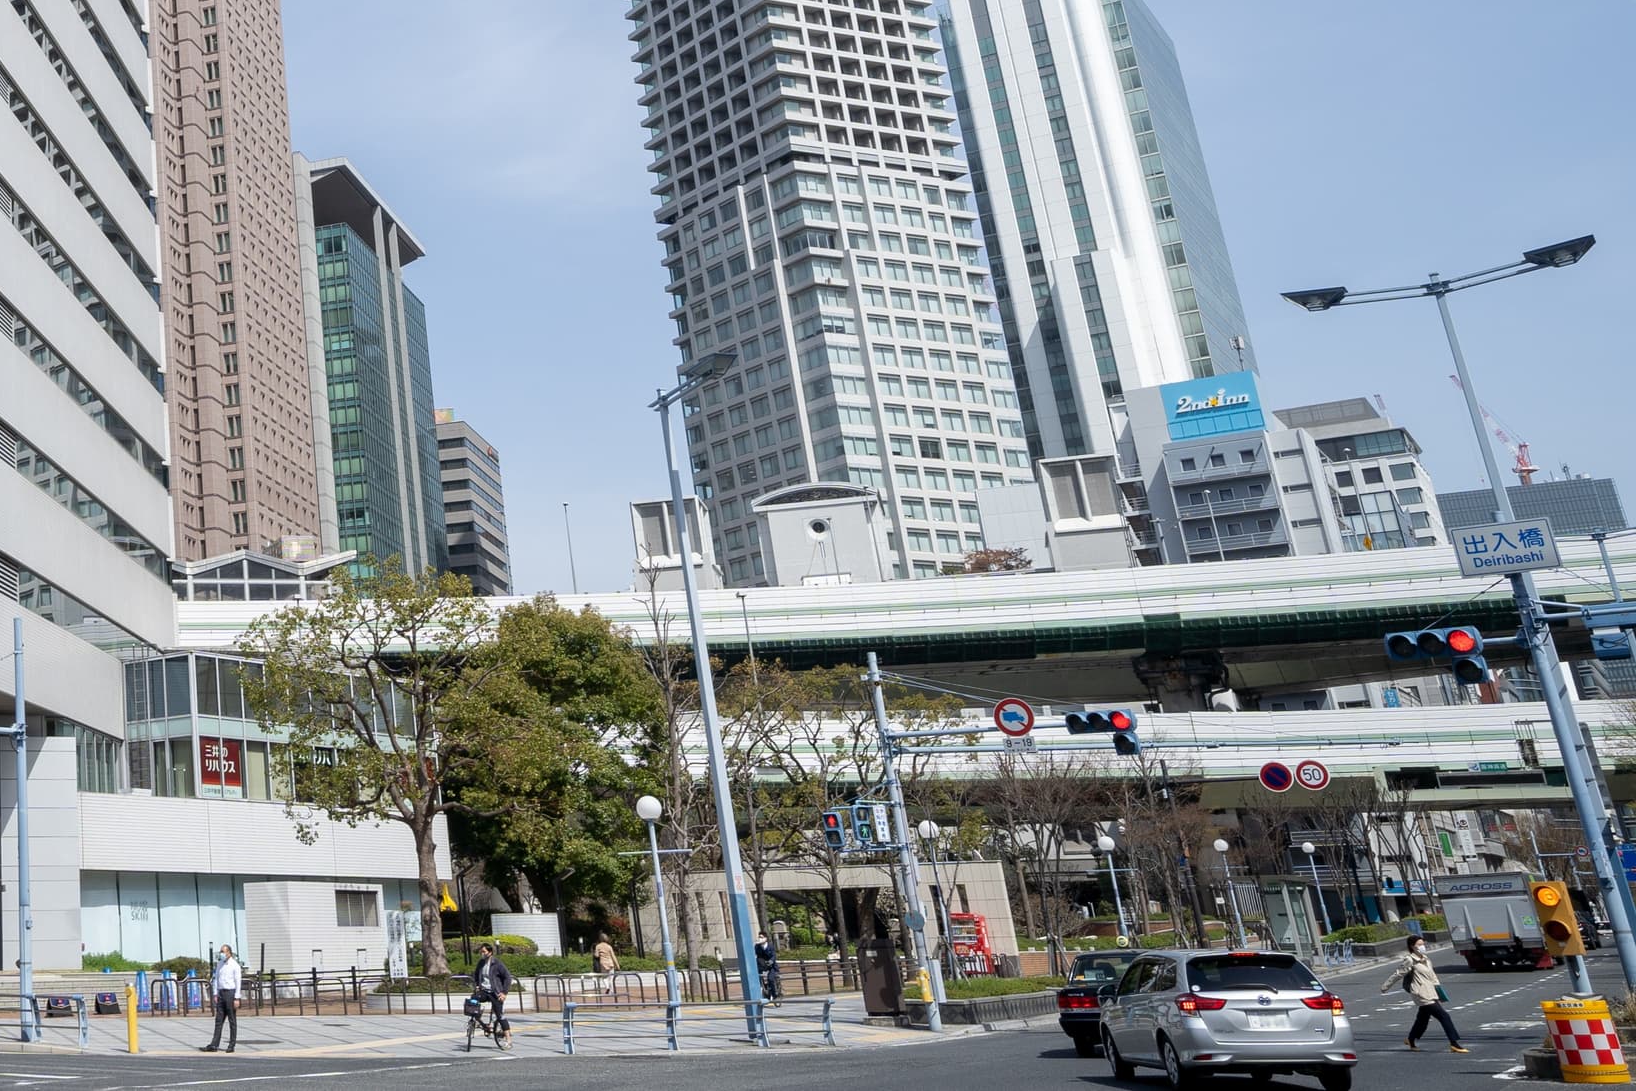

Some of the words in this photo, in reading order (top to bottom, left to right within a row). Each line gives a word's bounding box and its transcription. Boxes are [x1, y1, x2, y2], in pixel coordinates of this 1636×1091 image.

[1462, 527, 1545, 555] 出入橋
[1473, 550, 1544, 568] Deiribashi
[1302, 768, 1322, 781] 50
[1449, 882, 1513, 892] ACROSS
